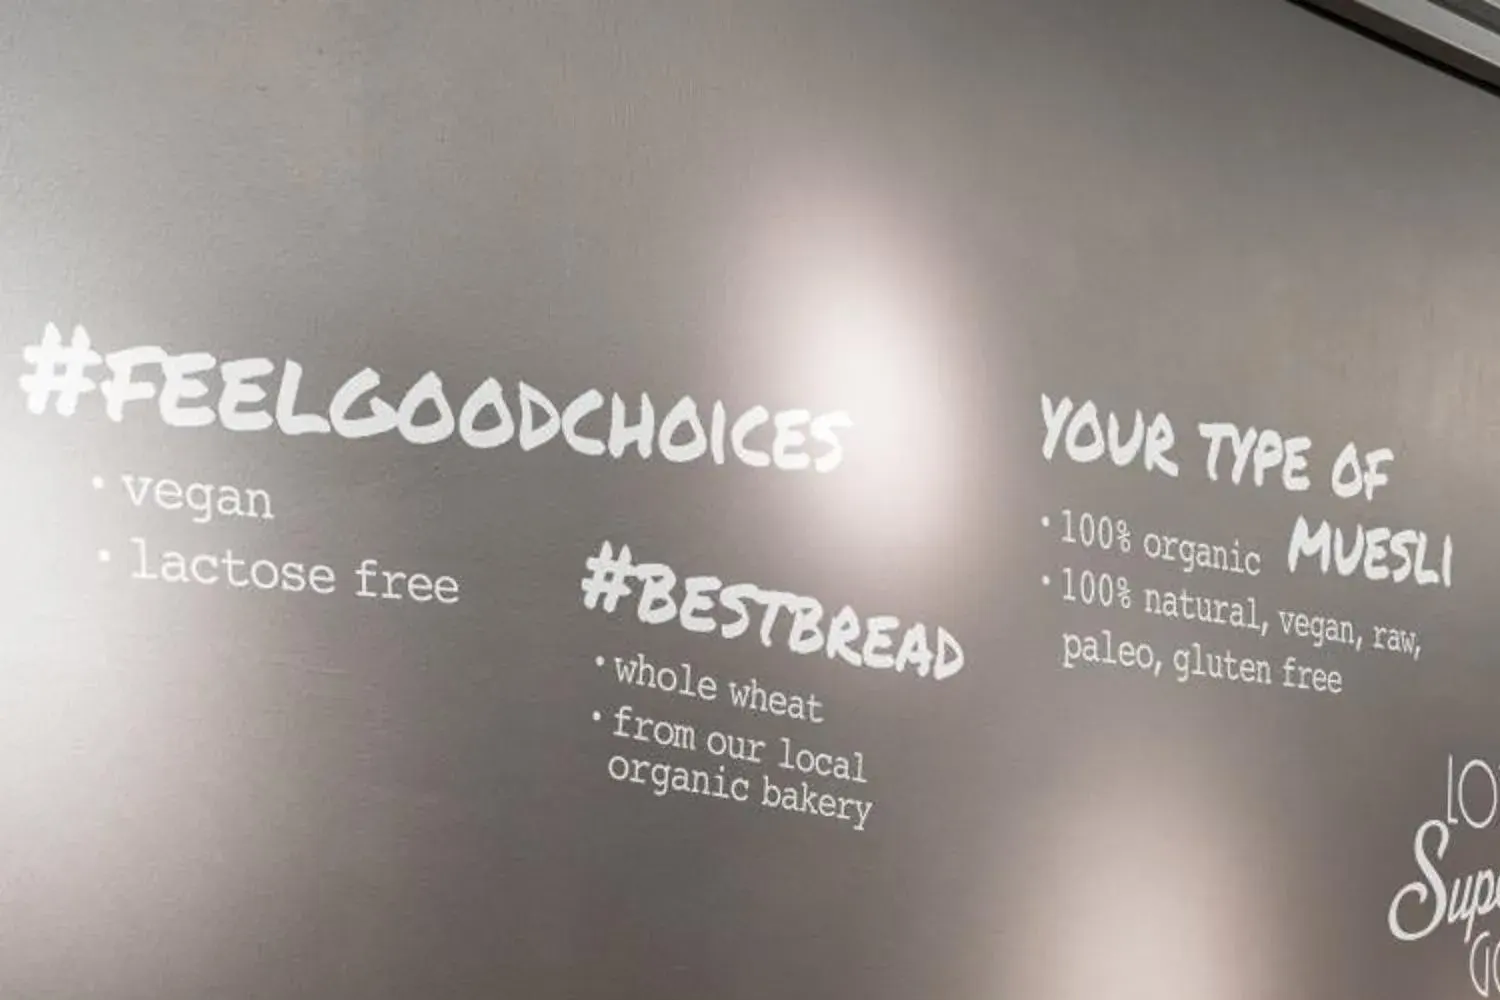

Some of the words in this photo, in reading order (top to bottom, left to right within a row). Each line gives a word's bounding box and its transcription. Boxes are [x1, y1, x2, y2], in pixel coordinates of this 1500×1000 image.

[18, 321, 853, 472] #FEELGOODCHOICES
[1040, 393, 1179, 477] YOUR
[1198, 422, 1312, 491] TYPE
[1331, 441, 1394, 501] OF
[122, 474, 274, 522] vegan
[130, 538, 336, 594] lactose
[355, 559, 461, 605] free
[1061, 509, 1132, 554] 100%
[1143, 531, 1261, 576] organic
[1287, 515, 1453, 588] MUESLI
[581, 540, 965, 681] #BESTBREAD
[1062, 567, 1132, 609] 100%
[1144, 585, 1270, 637] natural,
[1278, 609, 1364, 653] vegan,
[1372, 624, 1422, 661] raw,
[614, 653, 718, 700] whole
[728, 680, 824, 724] wheat
[1062, 630, 1162, 677] paleo,
[1173, 644, 1271, 685] gluten
[1282, 657, 1343, 694] free
[612, 706, 696, 751] from
[707, 731, 766, 763] our
[779, 738, 868, 784] local
[608, 755, 750, 802] organic
[762, 775, 873, 831] bakery
